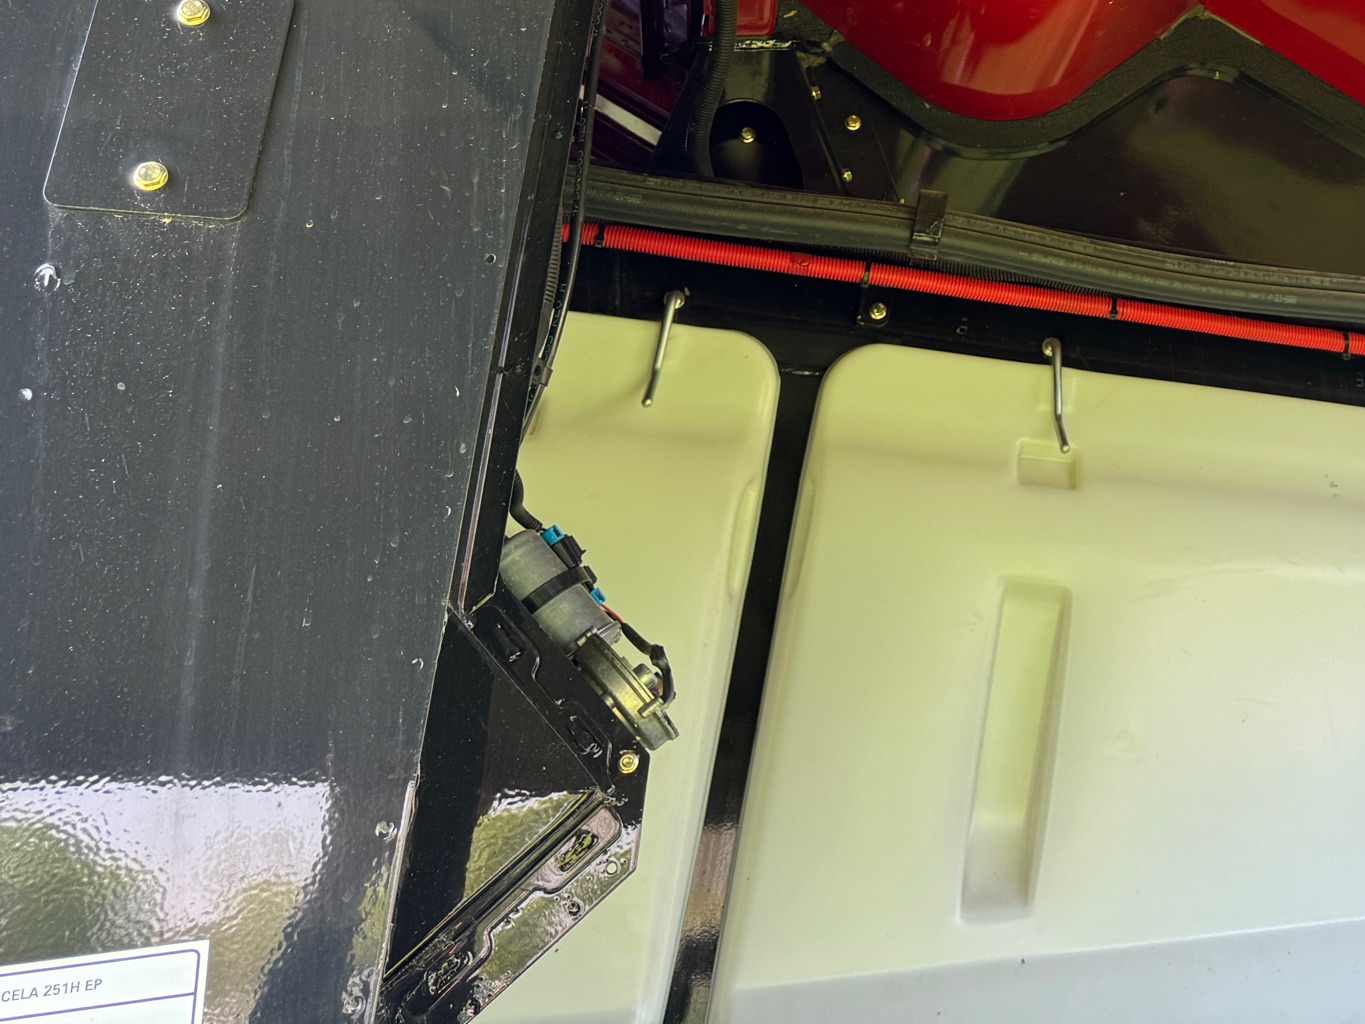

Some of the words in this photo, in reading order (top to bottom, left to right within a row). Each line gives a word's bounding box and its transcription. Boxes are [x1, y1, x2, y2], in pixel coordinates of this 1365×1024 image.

[0, 987, 39, 1003] CELA
[43, 981, 80, 997] 251H
[85, 978, 103, 991] EP
